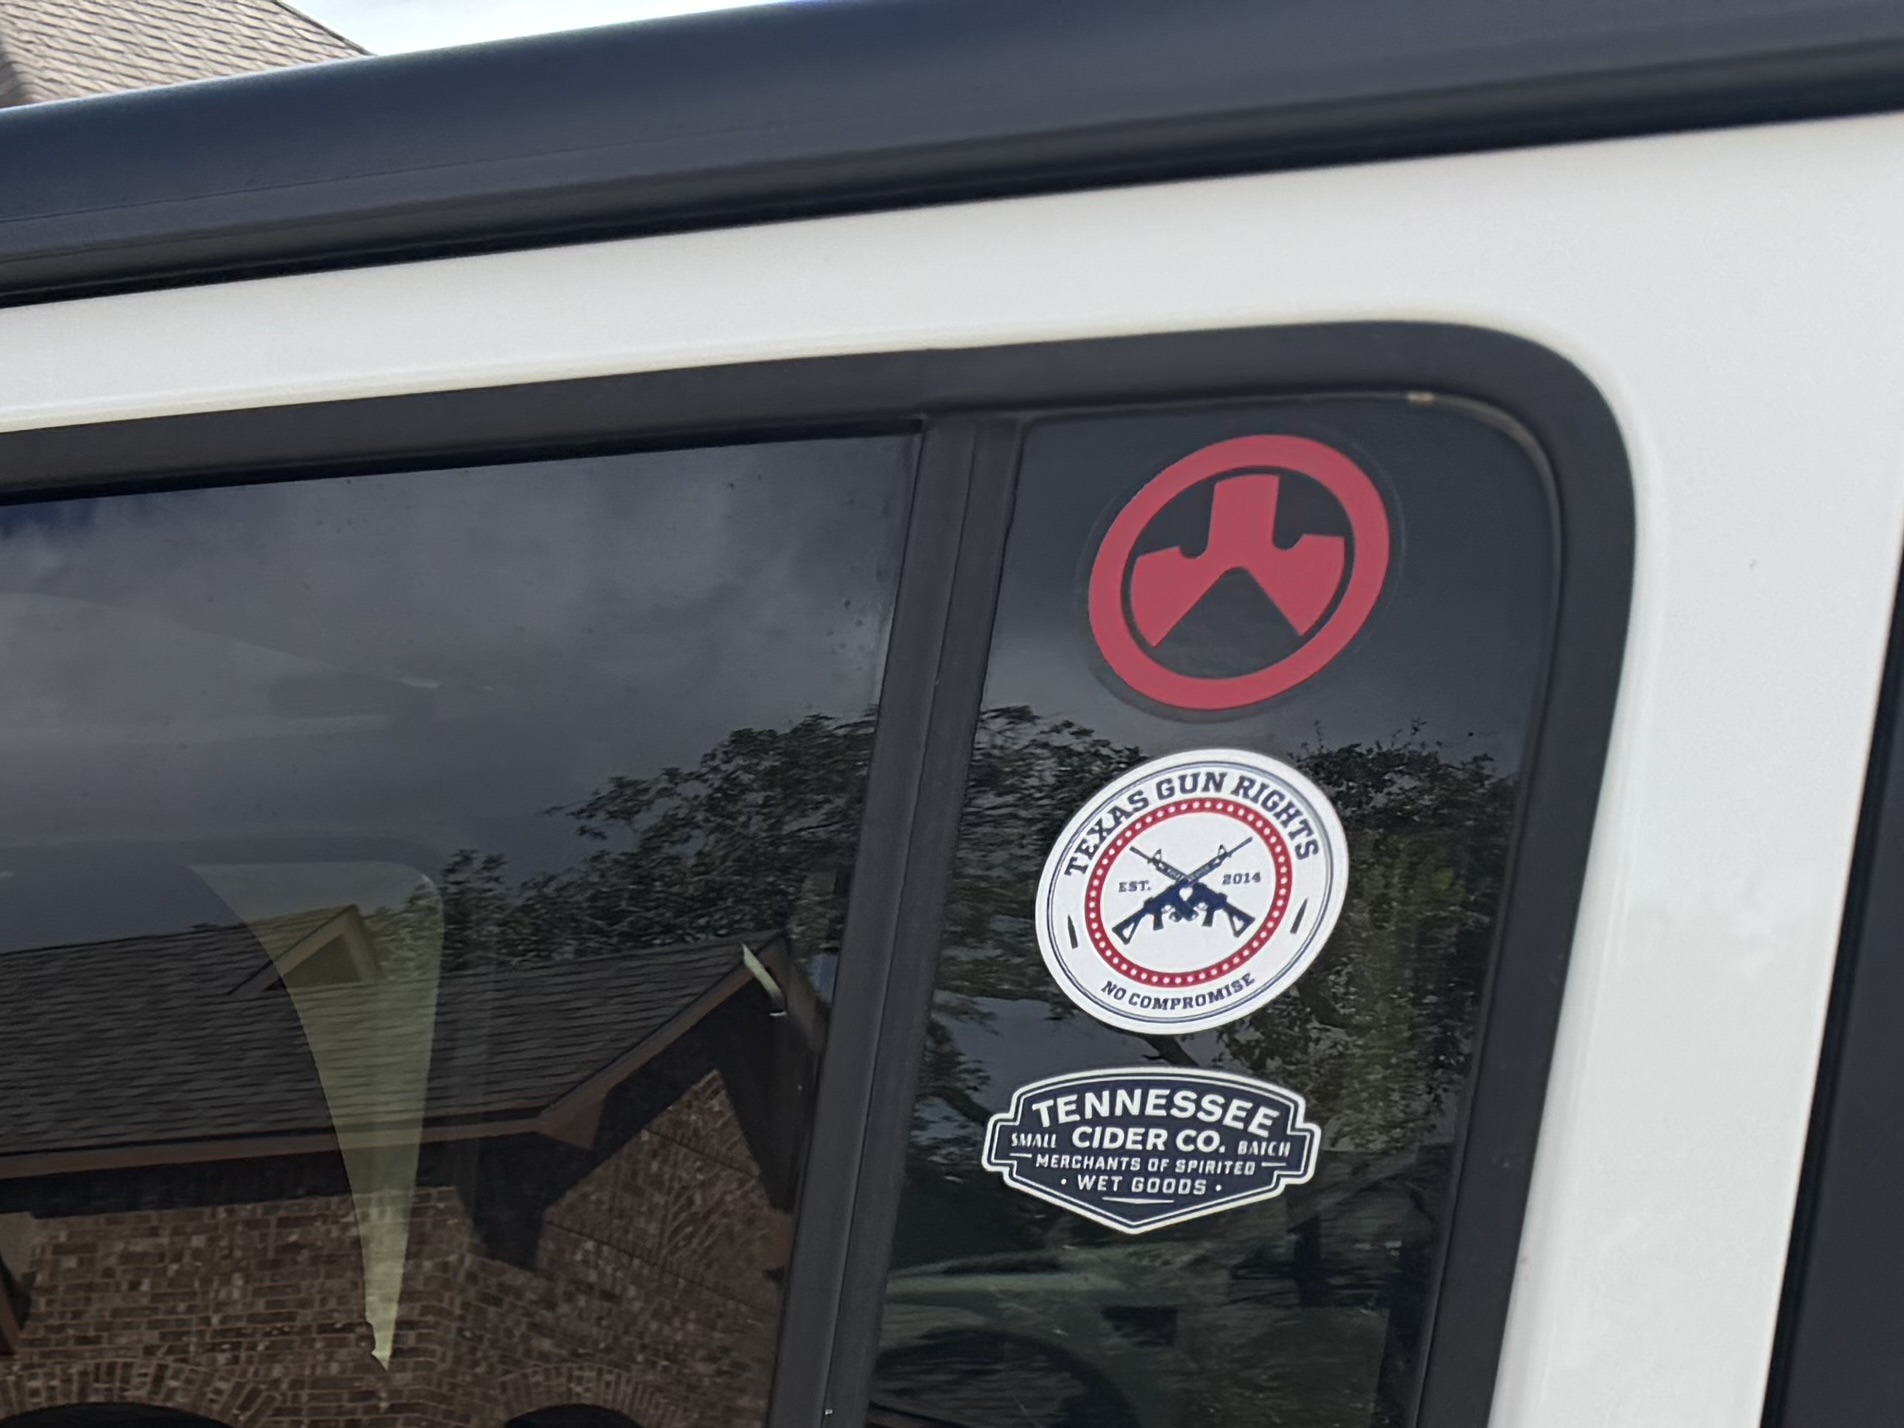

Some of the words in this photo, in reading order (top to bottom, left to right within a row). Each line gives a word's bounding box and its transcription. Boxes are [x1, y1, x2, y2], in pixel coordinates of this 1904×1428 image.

[1064, 789, 1150, 878] TEXAS
[1155, 771, 1228, 801] GUN
[1230, 774, 1319, 861] RIGHTS
[1118, 880, 1152, 893] EST.
[1222, 871, 1262, 886] 2014
[1101, 980, 1128, 1002] NO
[1128, 972, 1256, 1011] COMPROMISE
[1031, 1088, 1281, 1138] TENNESSEE
[1010, 1132, 1057, 1149] SMALL
[1071, 1125, 1169, 1151] CIDER
[1175, 1130, 1227, 1154] CO.
[1237, 1139, 1292, 1157] BATCH
[1035, 1153, 1141, 1171] MERCHANTS
[1147, 1157, 1169, 1173] OF
[1174, 1158, 1257, 1176] SPIRITED
[1076, 1174, 1123, 1192] WET
[1130, 1177, 1208, 1196] GOODS
